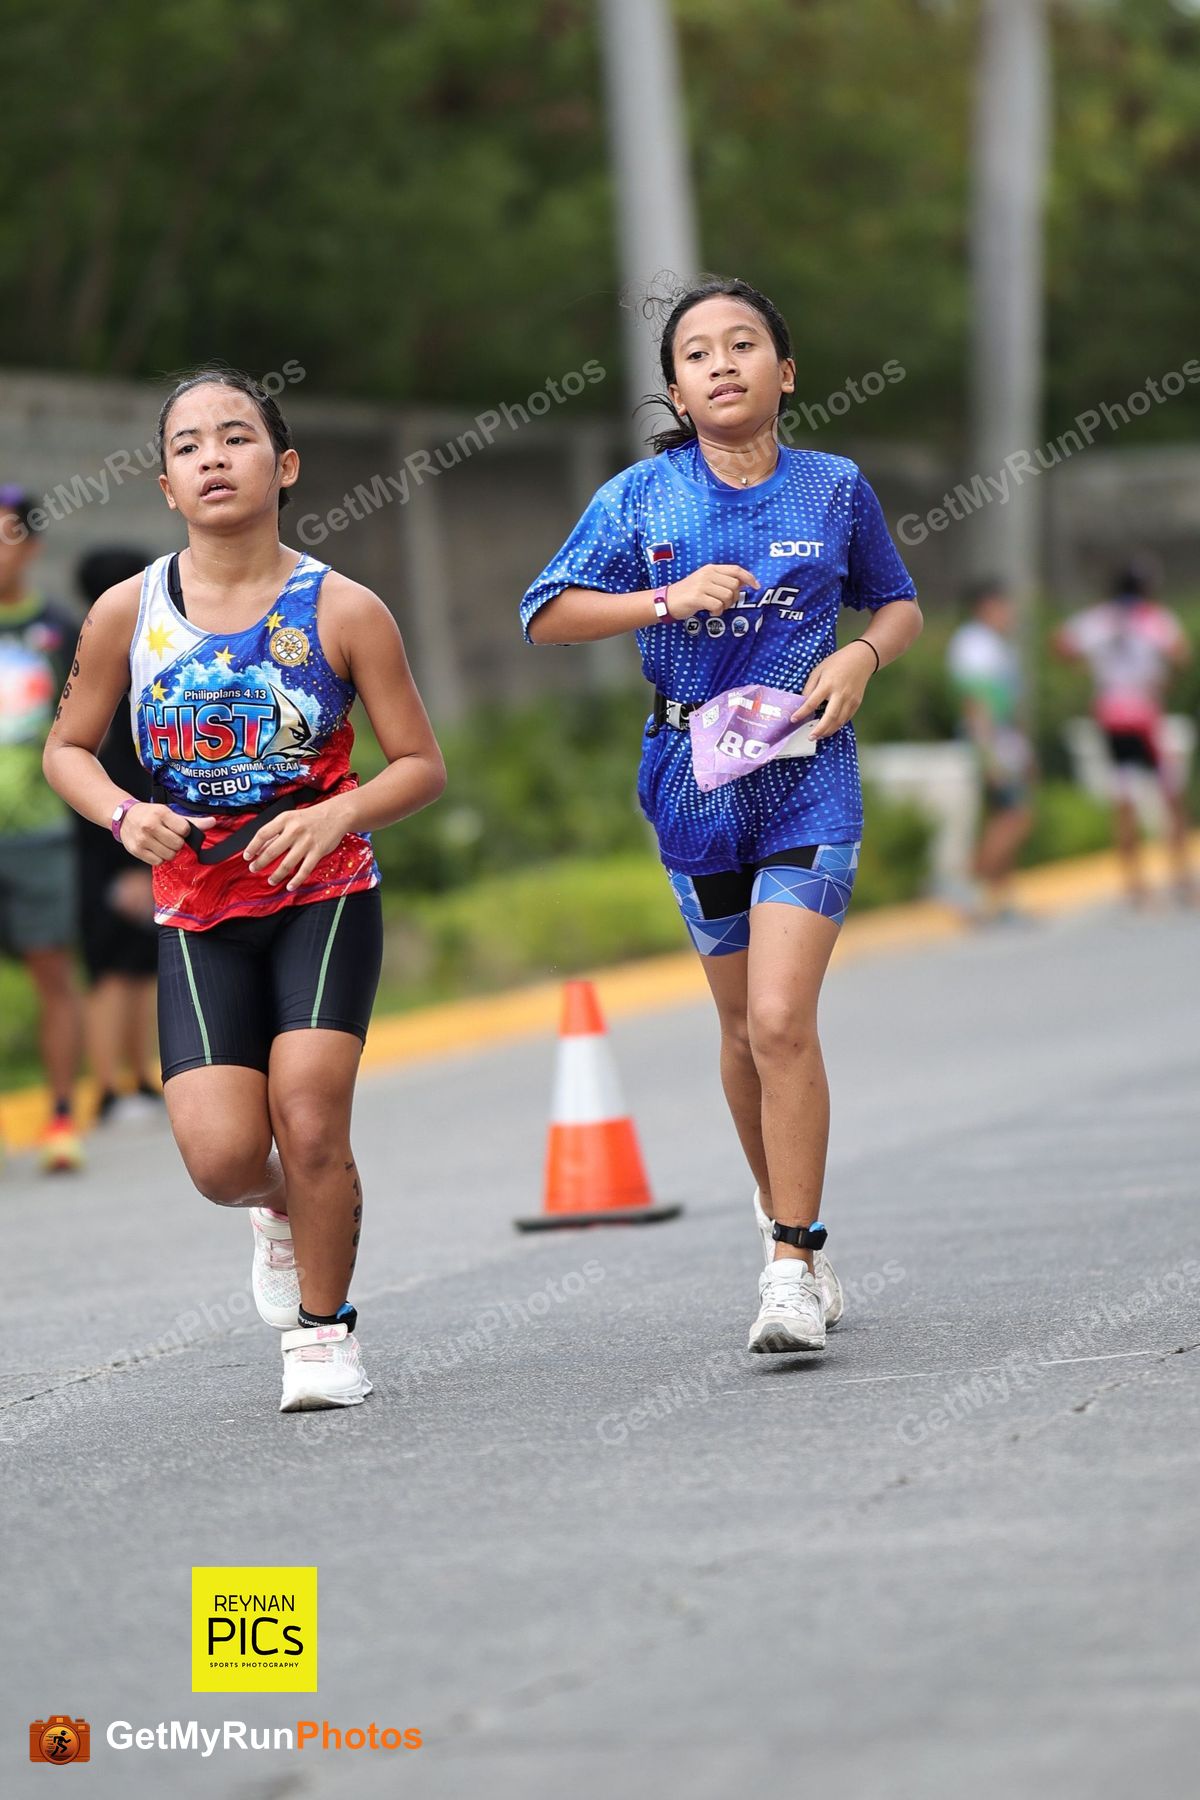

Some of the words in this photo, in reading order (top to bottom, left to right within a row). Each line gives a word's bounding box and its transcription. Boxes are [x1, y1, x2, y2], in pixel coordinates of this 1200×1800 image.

[730, 586, 800, 609] LAG
[778, 608, 805, 621] TRI
[145, 703, 275, 762] HIST
[197, 775, 252, 796] CEBU
